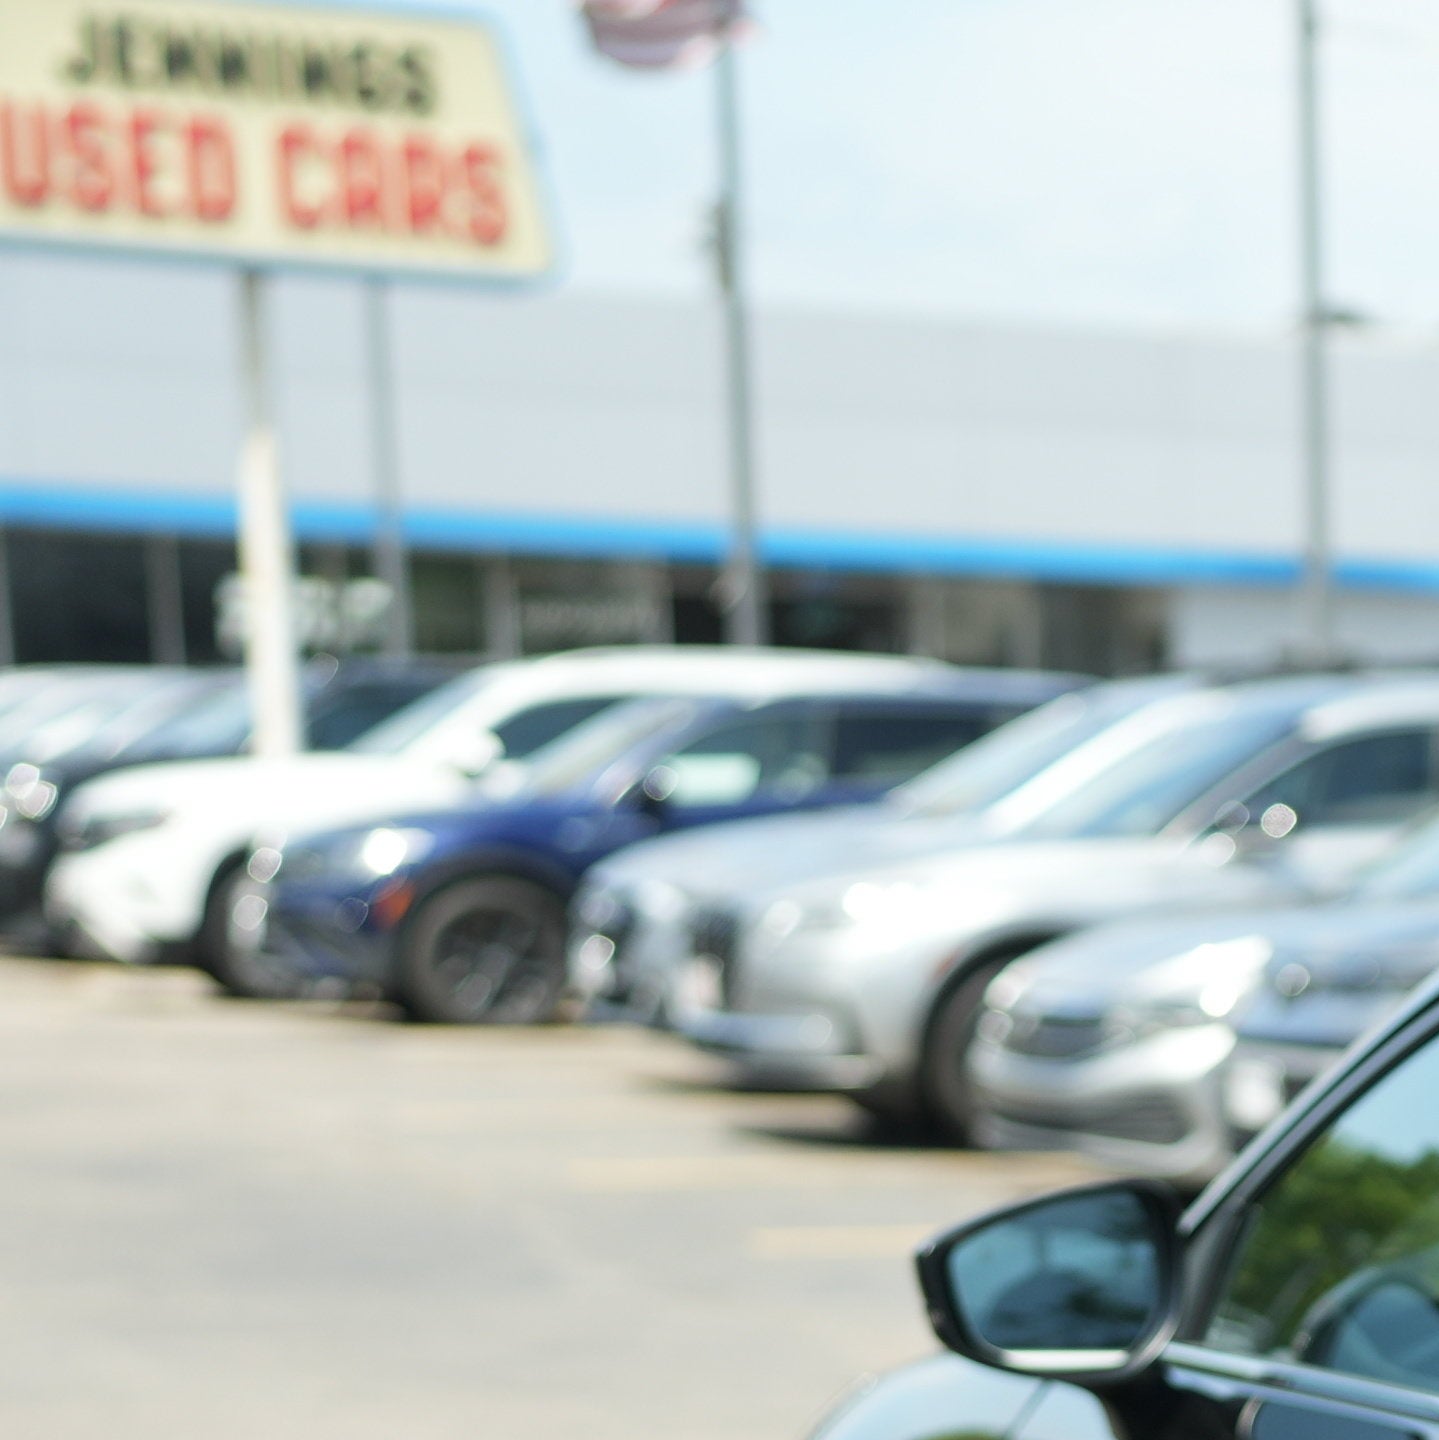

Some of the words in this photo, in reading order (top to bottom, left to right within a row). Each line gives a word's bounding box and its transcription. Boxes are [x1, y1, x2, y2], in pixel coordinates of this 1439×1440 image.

[66, 16, 436, 114] JENNINGS
[0, 98, 238, 220] USED
[278, 121, 509, 248] CARS
